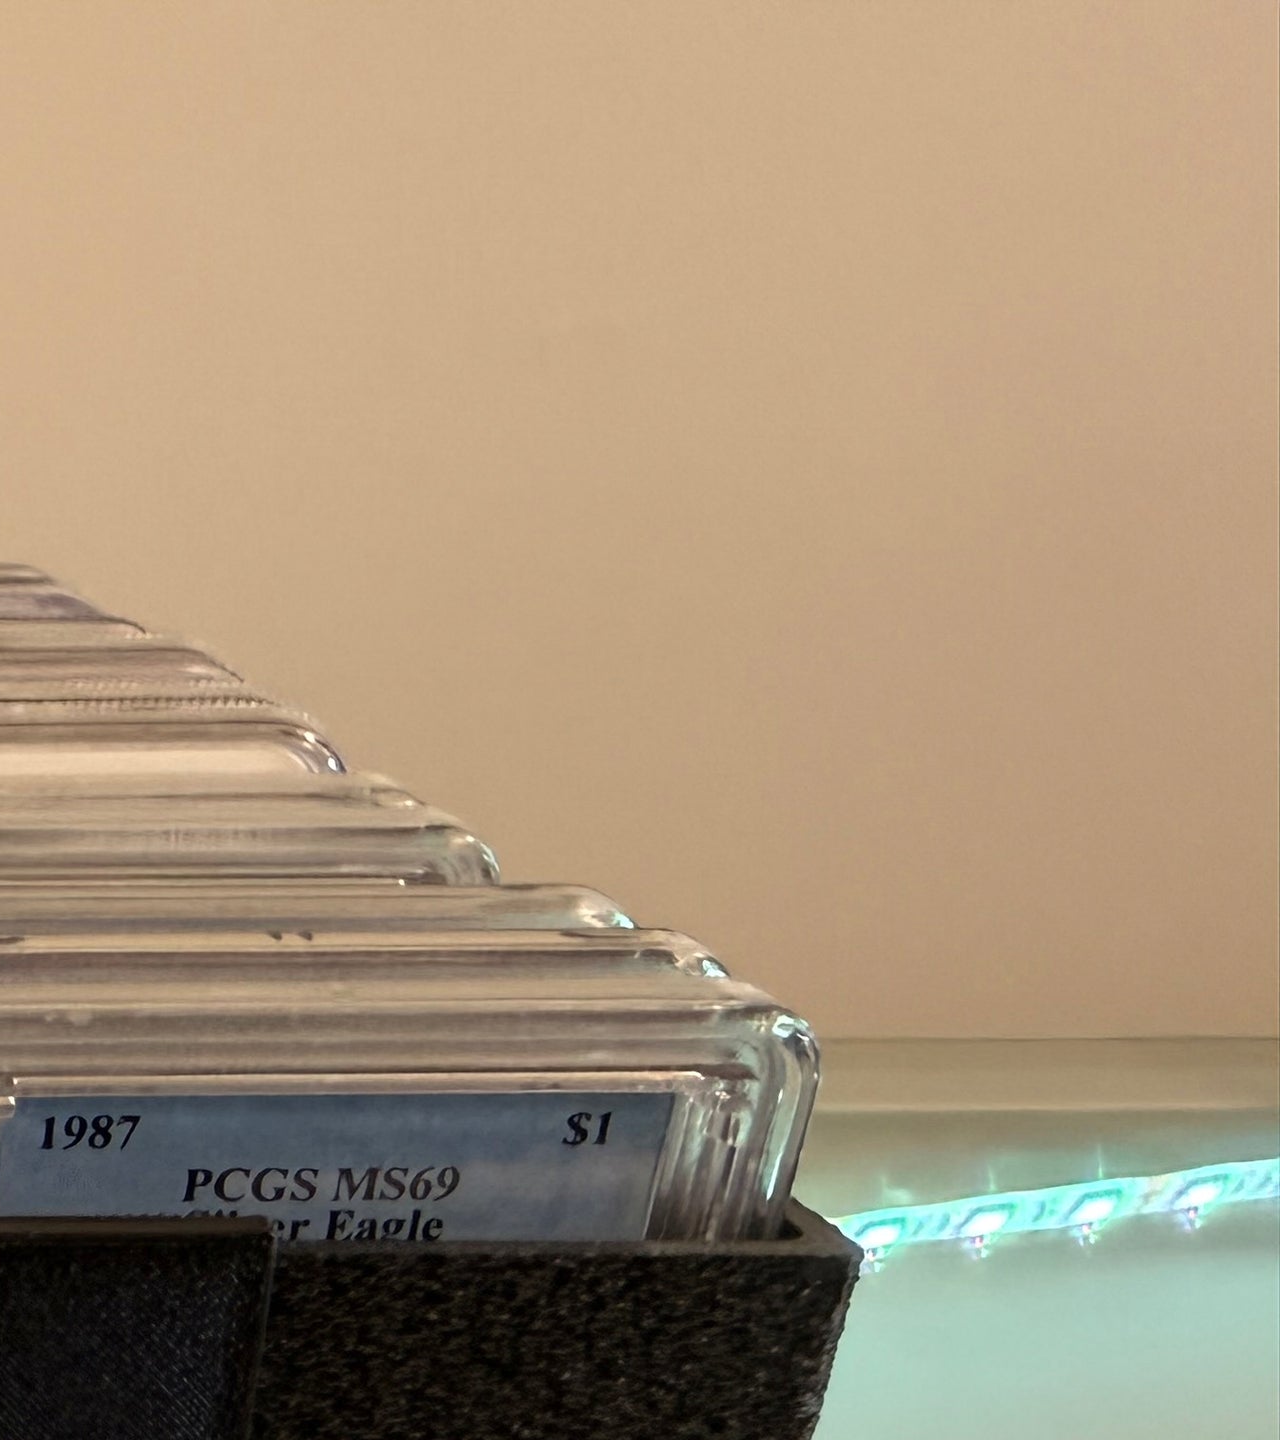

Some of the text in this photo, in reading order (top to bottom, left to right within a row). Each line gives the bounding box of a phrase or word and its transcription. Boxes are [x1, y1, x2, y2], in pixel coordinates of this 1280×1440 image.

[41, 1112, 612, 1150] 1987 $1
[182, 1166, 461, 1202] PCGS MS69
[326, 1208, 445, 1242] Eagle
